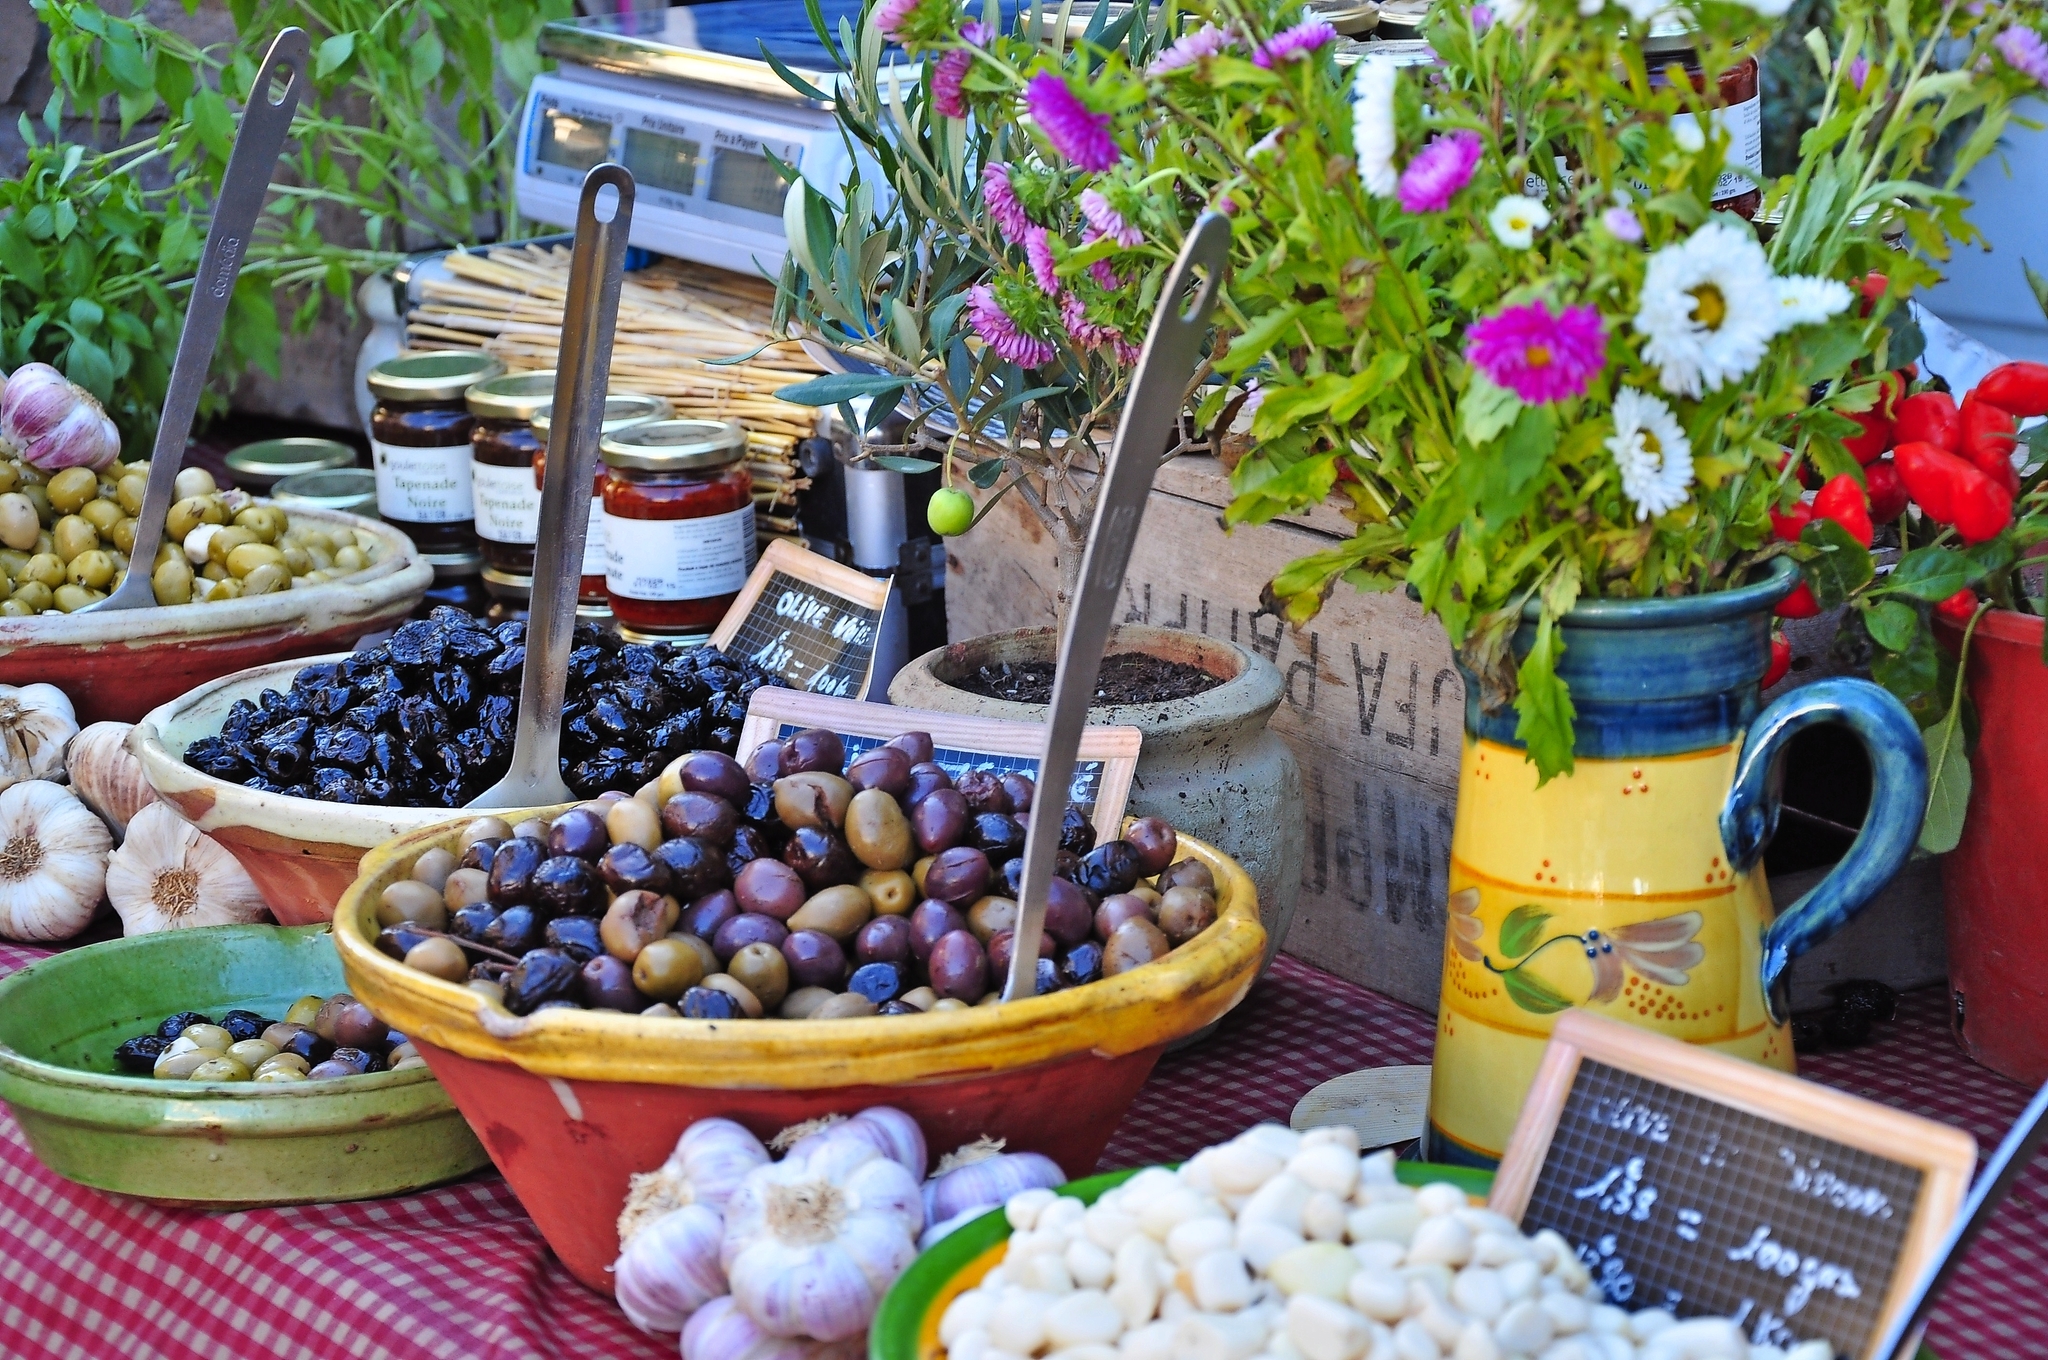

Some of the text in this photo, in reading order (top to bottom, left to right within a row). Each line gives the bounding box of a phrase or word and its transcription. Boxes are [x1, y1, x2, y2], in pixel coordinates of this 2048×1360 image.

[394, 477, 458, 492] Tapenade
[407, 496, 447, 508] Noire
[479, 493, 535, 511] Tapenade
[488, 513, 524, 529] Noire
